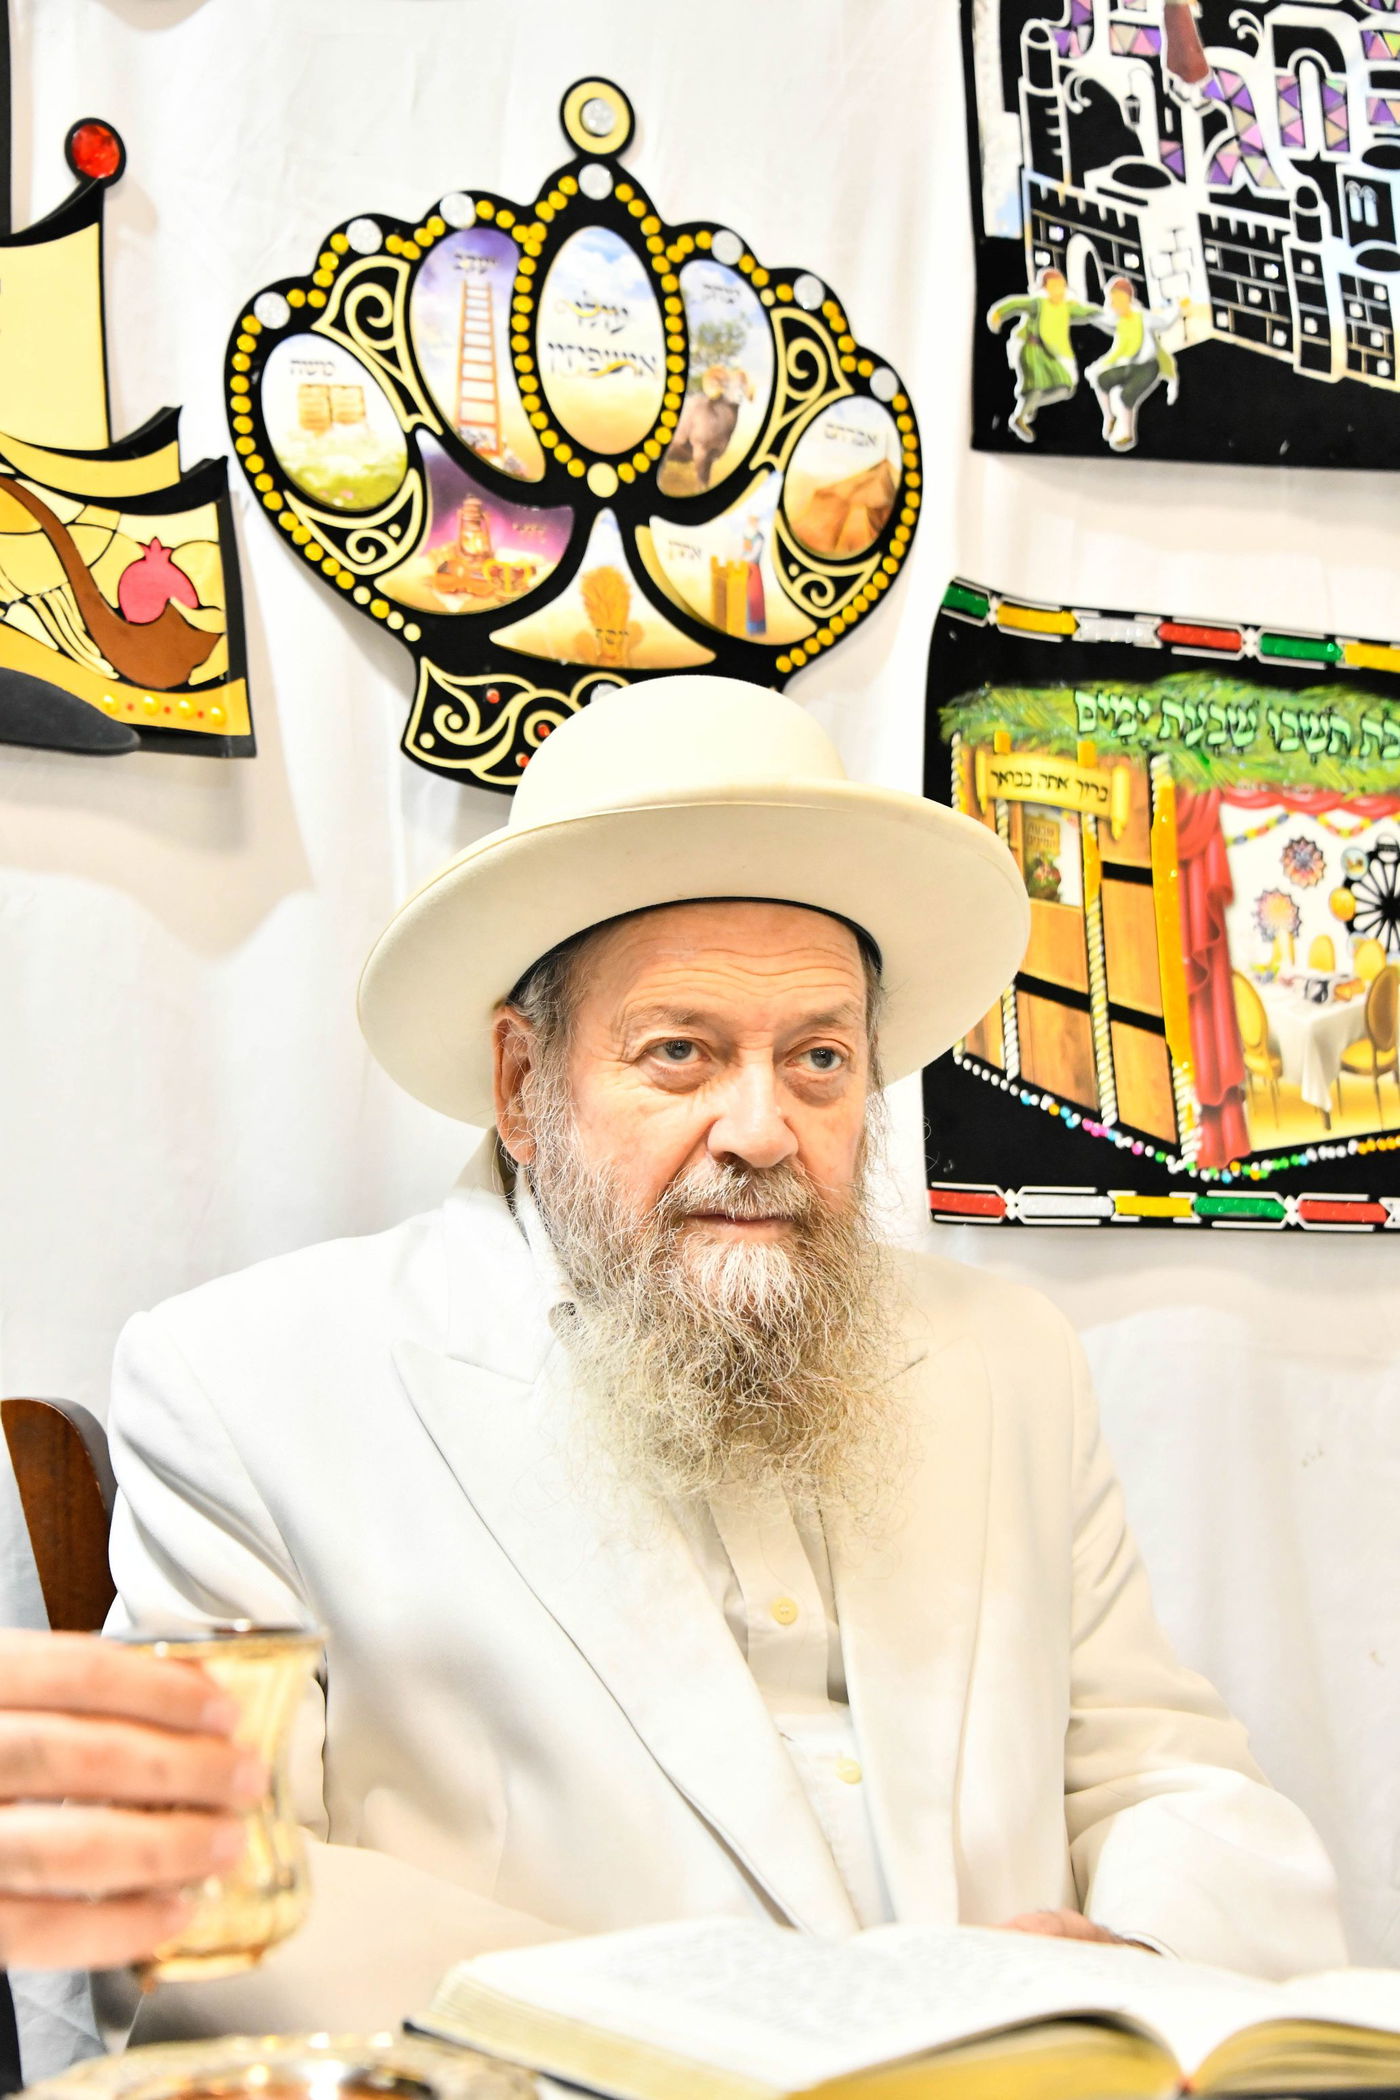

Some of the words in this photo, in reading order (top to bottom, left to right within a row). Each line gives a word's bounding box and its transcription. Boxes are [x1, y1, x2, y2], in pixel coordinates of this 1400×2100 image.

[289, 359, 334, 376] משה
[1037, 772, 1070, 790] אתה
[1076, 778, 1110, 804] ברוך
